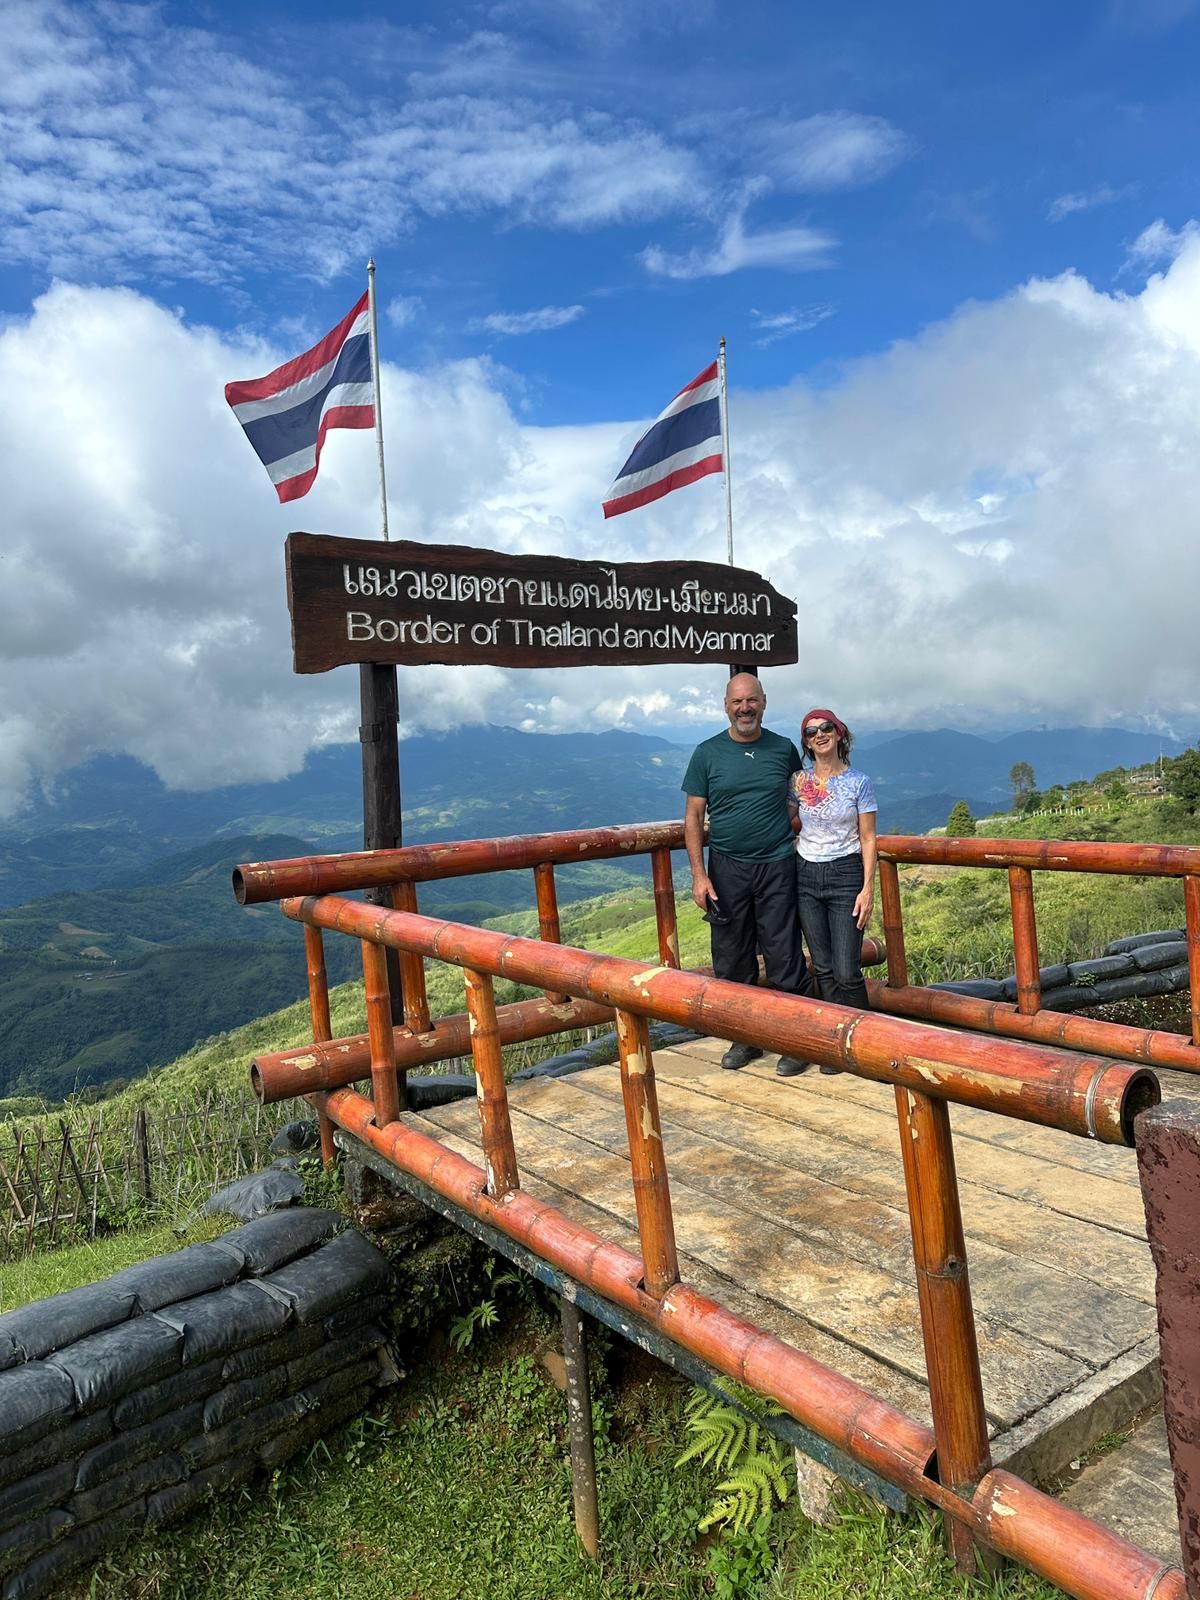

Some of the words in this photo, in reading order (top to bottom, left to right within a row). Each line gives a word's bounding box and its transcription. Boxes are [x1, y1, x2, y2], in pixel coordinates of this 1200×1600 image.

[343, 564, 772, 617] แนวเขตชายแดนไทย-เมียนมา
[346, 611, 465, 644] Border
[470, 618, 501, 645] of
[505, 618, 620, 648] Thailand
[623, 624, 669, 649] and
[672, 624, 775, 654] Myanmar
